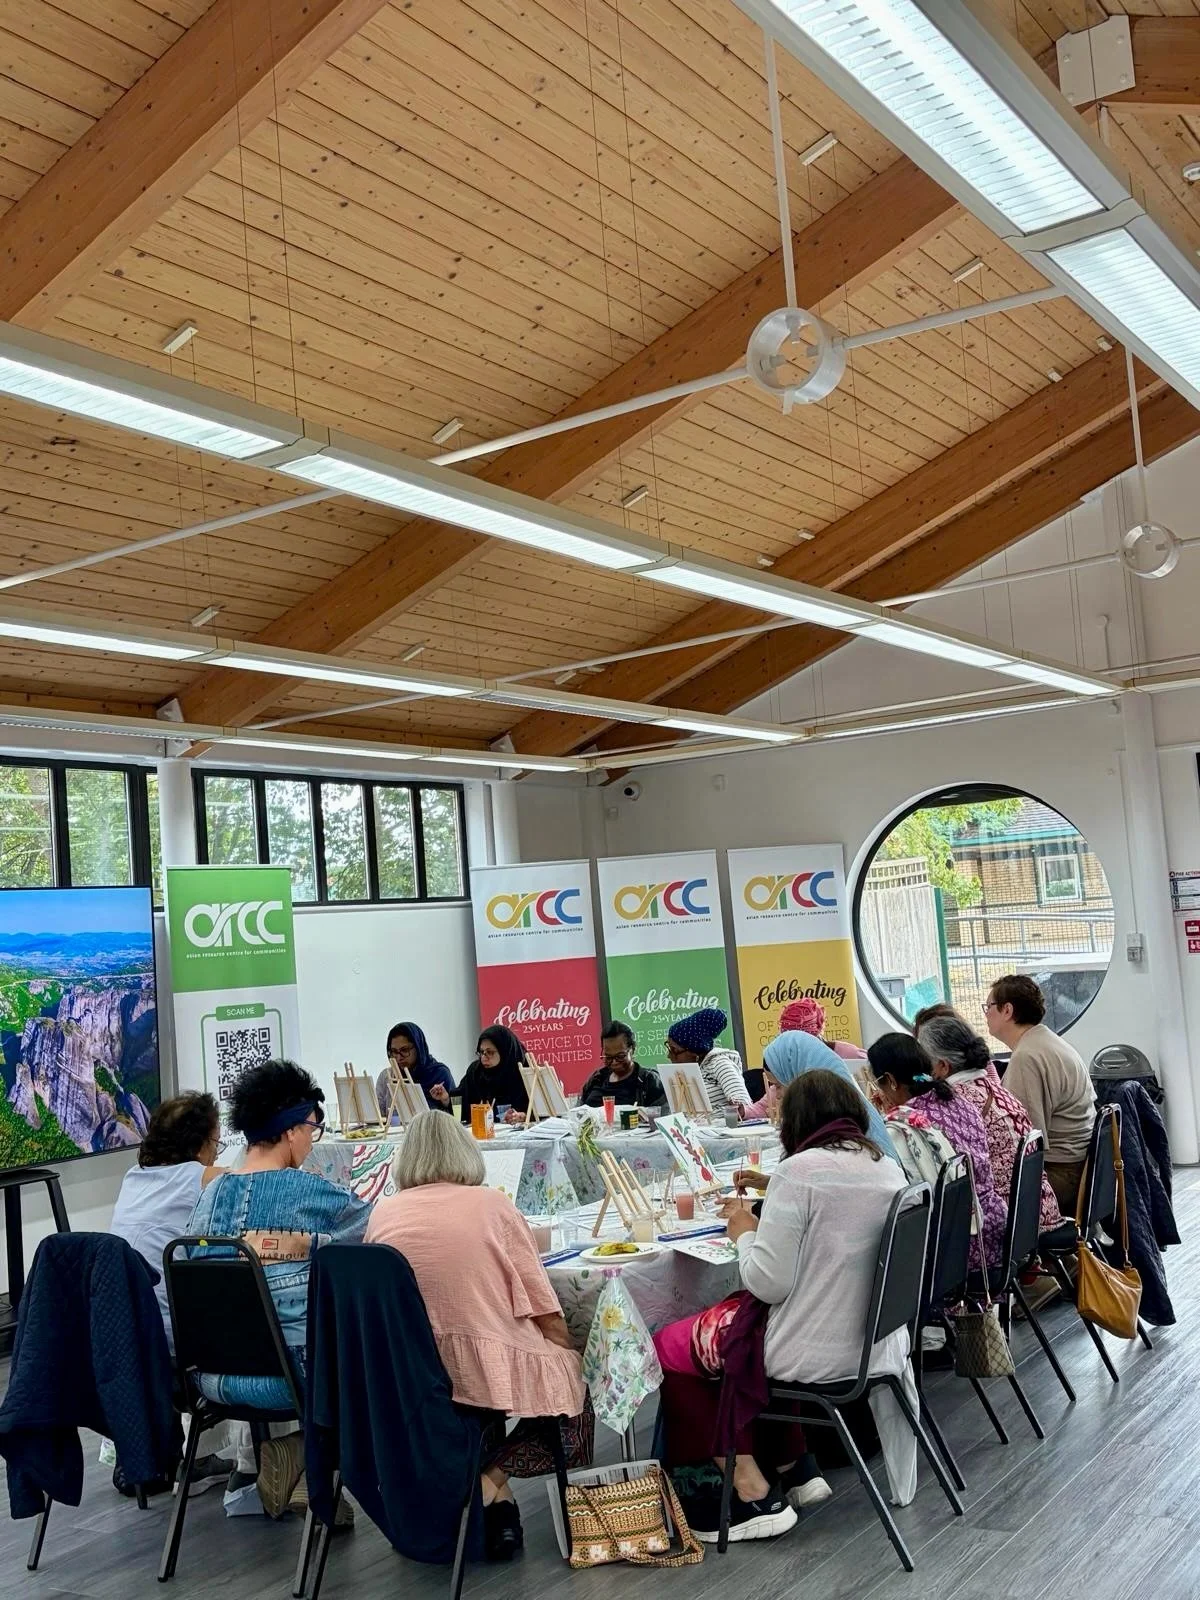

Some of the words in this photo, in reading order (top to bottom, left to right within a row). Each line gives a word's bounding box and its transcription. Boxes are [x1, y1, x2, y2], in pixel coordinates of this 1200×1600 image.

[622, 987, 720, 1021] Celebrating
[753, 978, 847, 1011] Celebrating
[226, 1008, 245, 1016] SCAN
[245, 1006, 256, 1015] ME
[493, 997, 592, 1028] Celebrating
[757, 1020, 775, 1032] OF
[831, 1014, 849, 1026] TO
[573, 1034, 592, 1047] TO
